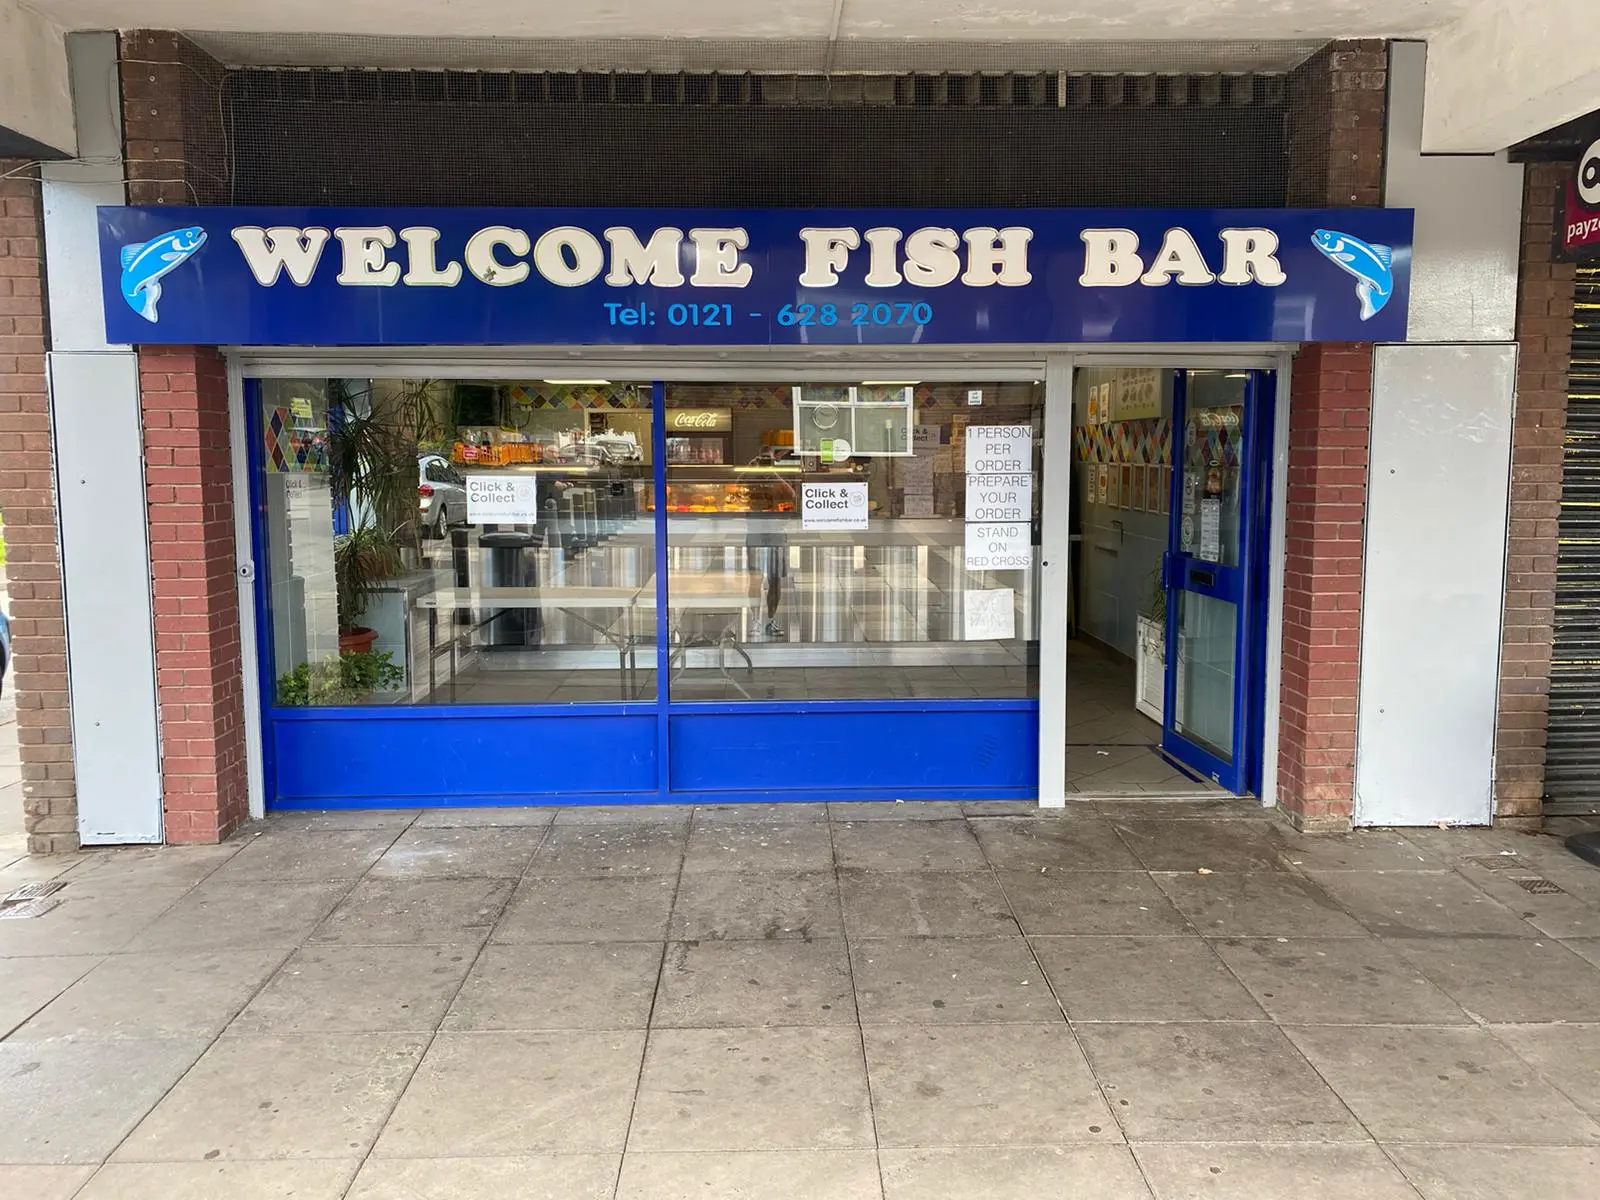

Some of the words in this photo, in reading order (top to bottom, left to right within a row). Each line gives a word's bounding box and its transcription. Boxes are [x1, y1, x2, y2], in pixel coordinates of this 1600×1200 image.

[1567, 217, 1600, 243] payz
[231, 225, 753, 288] WELCOME
[799, 225, 1034, 288] FISH
[1078, 226, 1288, 287] BAR
[603, 302, 656, 326] Tel:
[668, 303, 733, 326] 0121
[777, 302, 838, 326] 628
[850, 302, 933, 326] 2070
[967, 428, 973, 438] 1
[977, 426, 1032, 439] PERSON
[985, 443, 1012, 455] PER
[974, 459, 1021, 472] ORDER
[469, 481, 502, 492] Click
[506, 481, 515, 492] &
[968, 475, 1029, 487] PREPARE
[470, 492, 516, 503] Collect
[804, 488, 836, 498] Click
[839, 488, 849, 498] &
[979, 491, 1017, 504] YOUR
[805, 499, 849, 510] Collect
[974, 507, 1021, 520] ORDER
[976, 526, 1019, 538] STAND
[988, 542, 1008, 553] ON
[966, 556, 989, 567] RED
[991, 555, 1030, 566] CROSS
